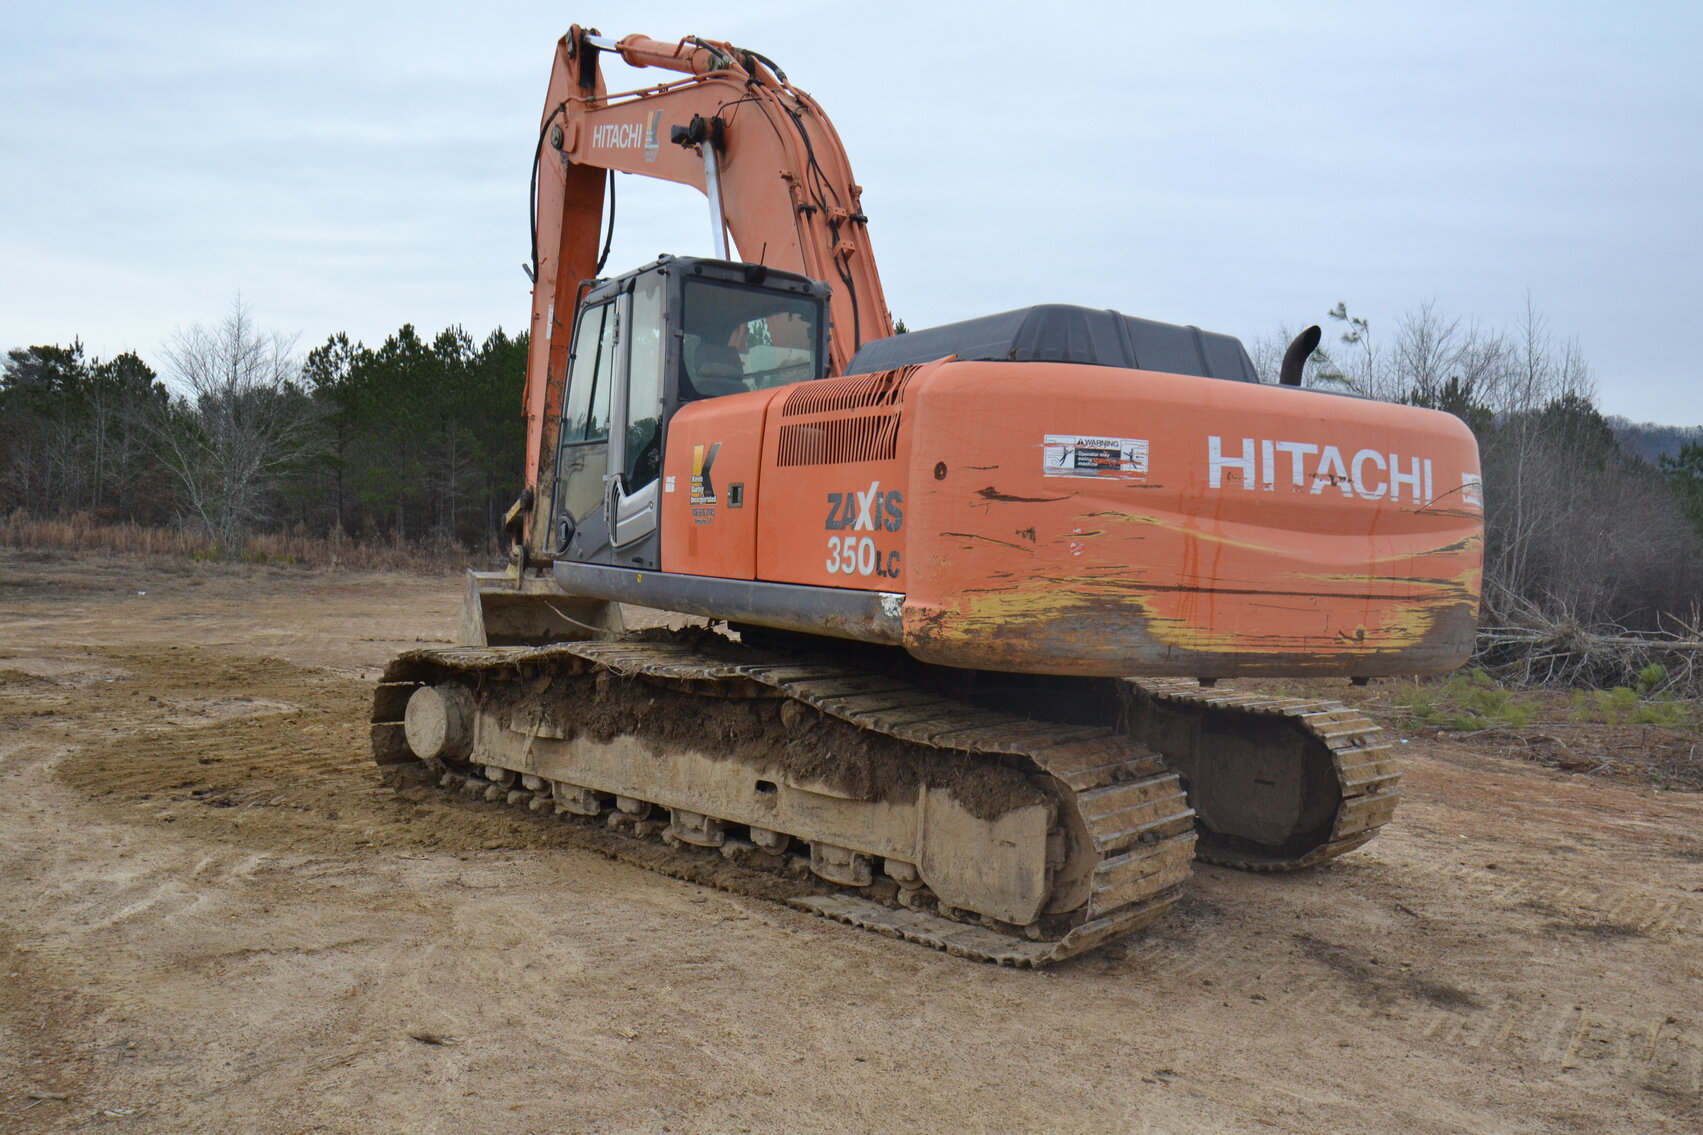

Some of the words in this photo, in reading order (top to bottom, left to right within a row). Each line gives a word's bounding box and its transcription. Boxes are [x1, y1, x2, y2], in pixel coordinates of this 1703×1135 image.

[592, 123, 643, 148] HITACHI
[1084, 440, 1119, 448] WARNING
[1208, 435, 1432, 506] HITACHI
[690, 496, 717, 505] Incorporated
[825, 481, 903, 533] ZAXIS
